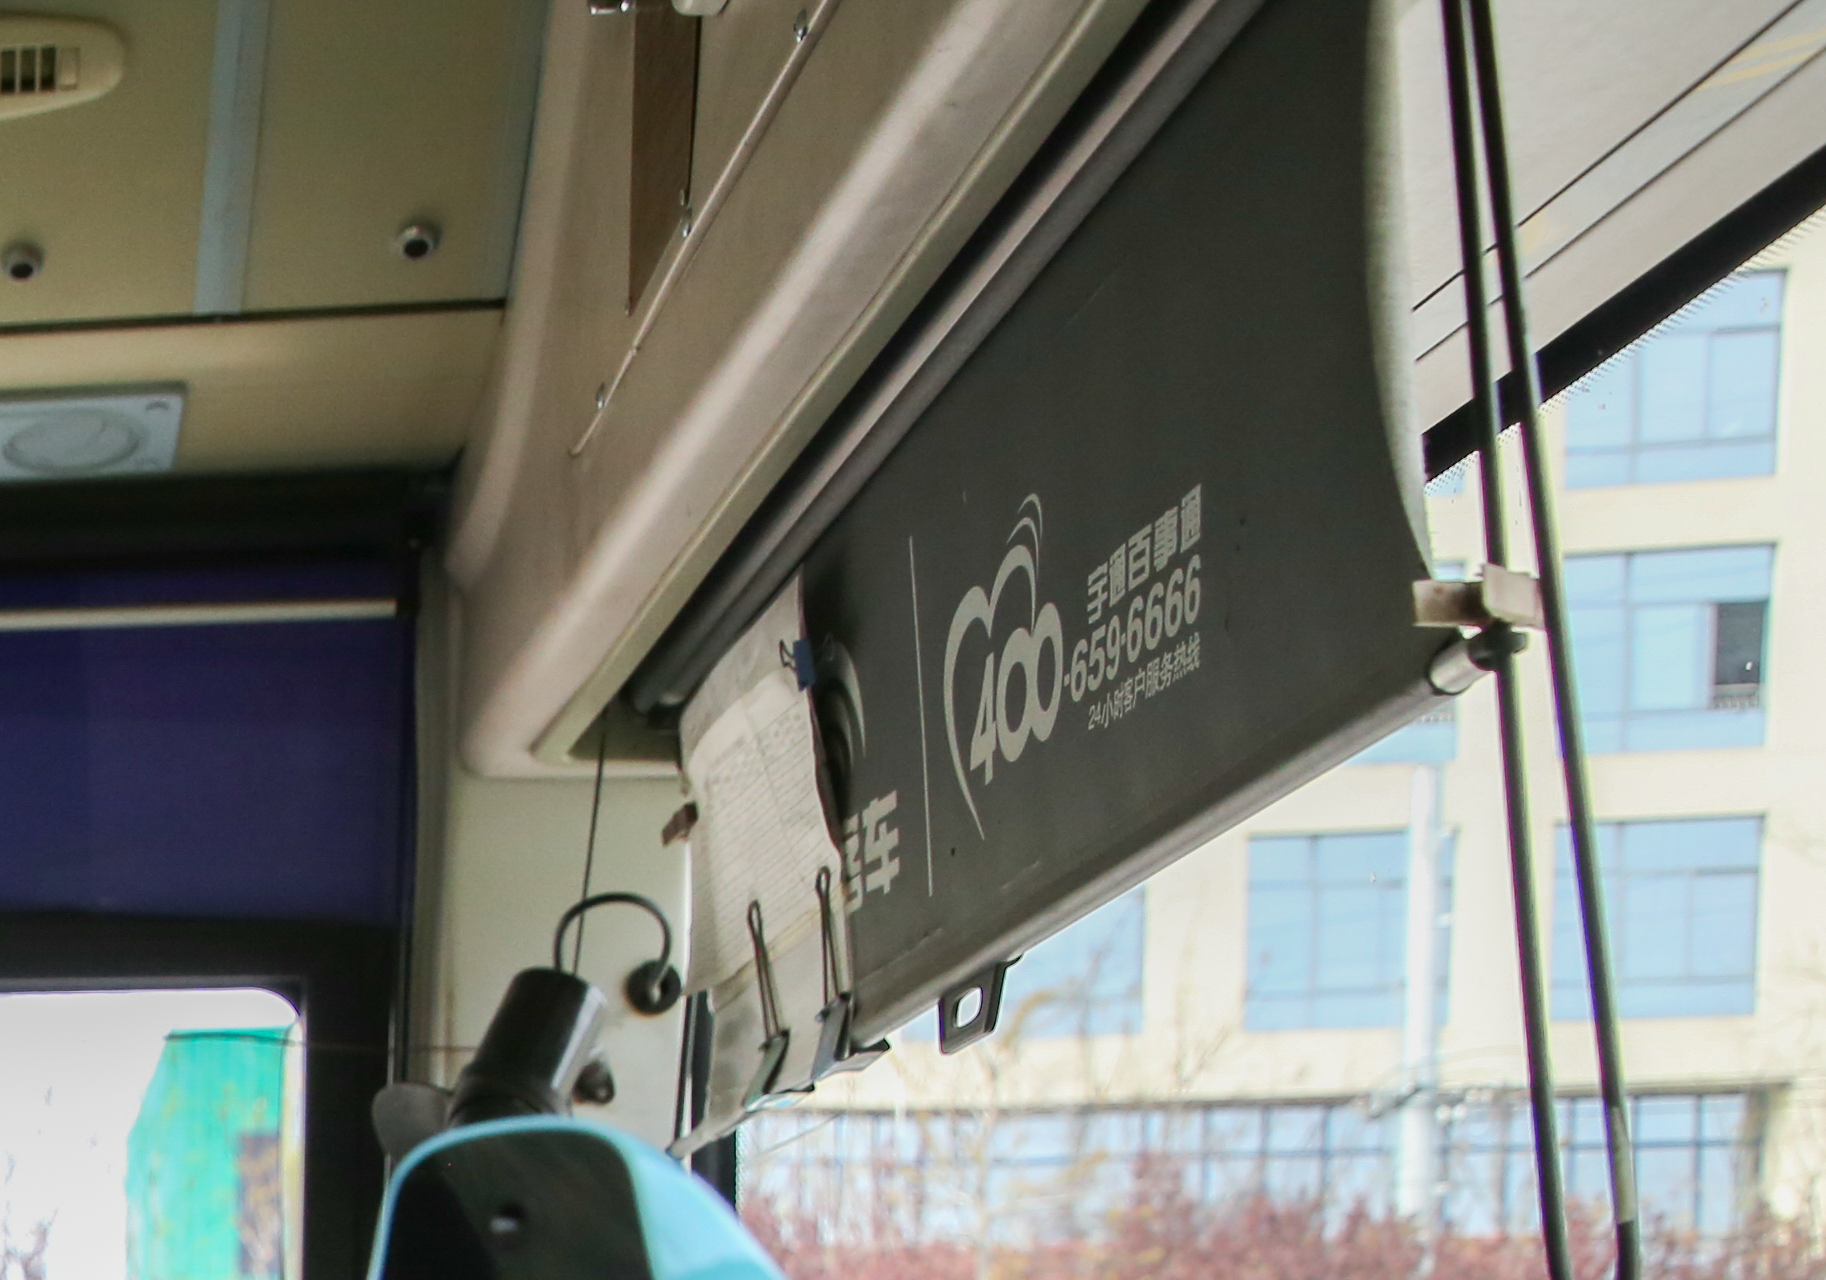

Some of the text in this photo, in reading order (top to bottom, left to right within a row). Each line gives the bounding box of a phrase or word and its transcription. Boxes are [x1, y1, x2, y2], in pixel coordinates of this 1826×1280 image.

[1087, 484, 1202, 625] 宇通百事通
[1087, 632, 1201, 731] 24小时客户服务热线
